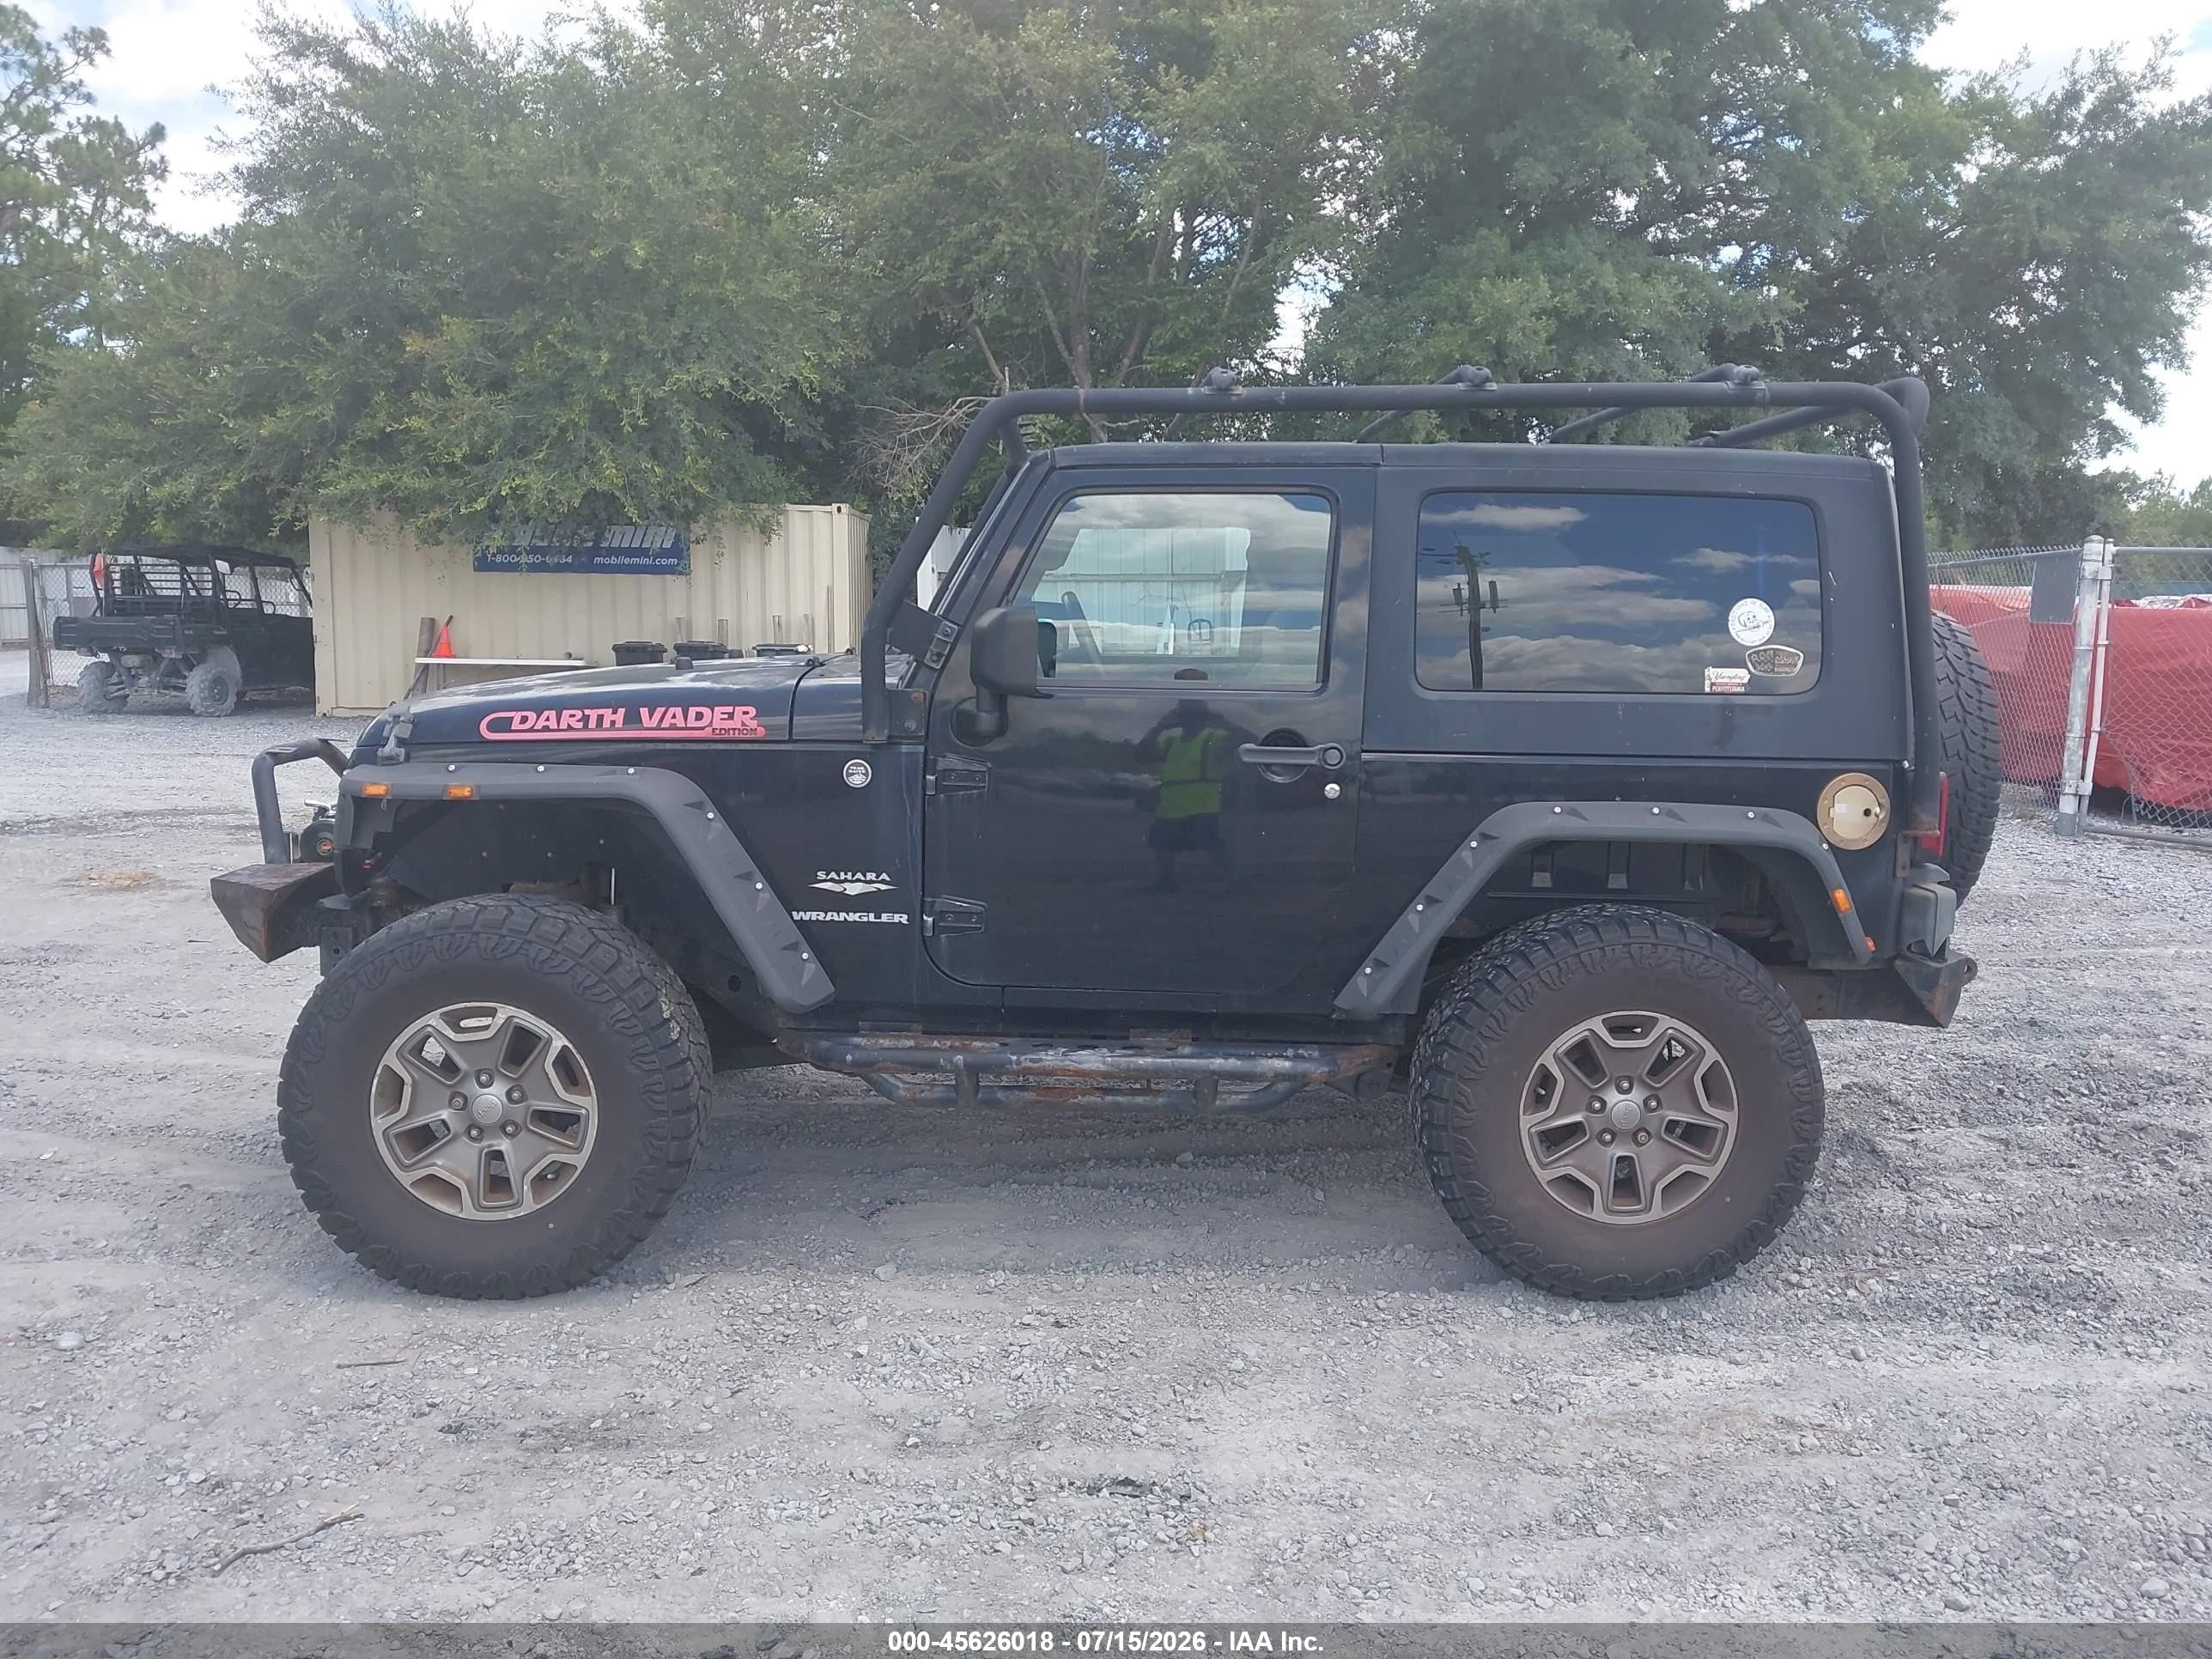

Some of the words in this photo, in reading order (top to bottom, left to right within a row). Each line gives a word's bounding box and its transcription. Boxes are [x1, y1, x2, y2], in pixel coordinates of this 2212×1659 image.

[593, 555, 678, 566] mobilemini.com
[510, 708, 626, 731] DARTH
[640, 706, 758, 729] VADER
[711, 727, 758, 736] EDITION
[817, 871, 891, 881] SAHARA
[792, 910, 910, 925] WRANGLER
